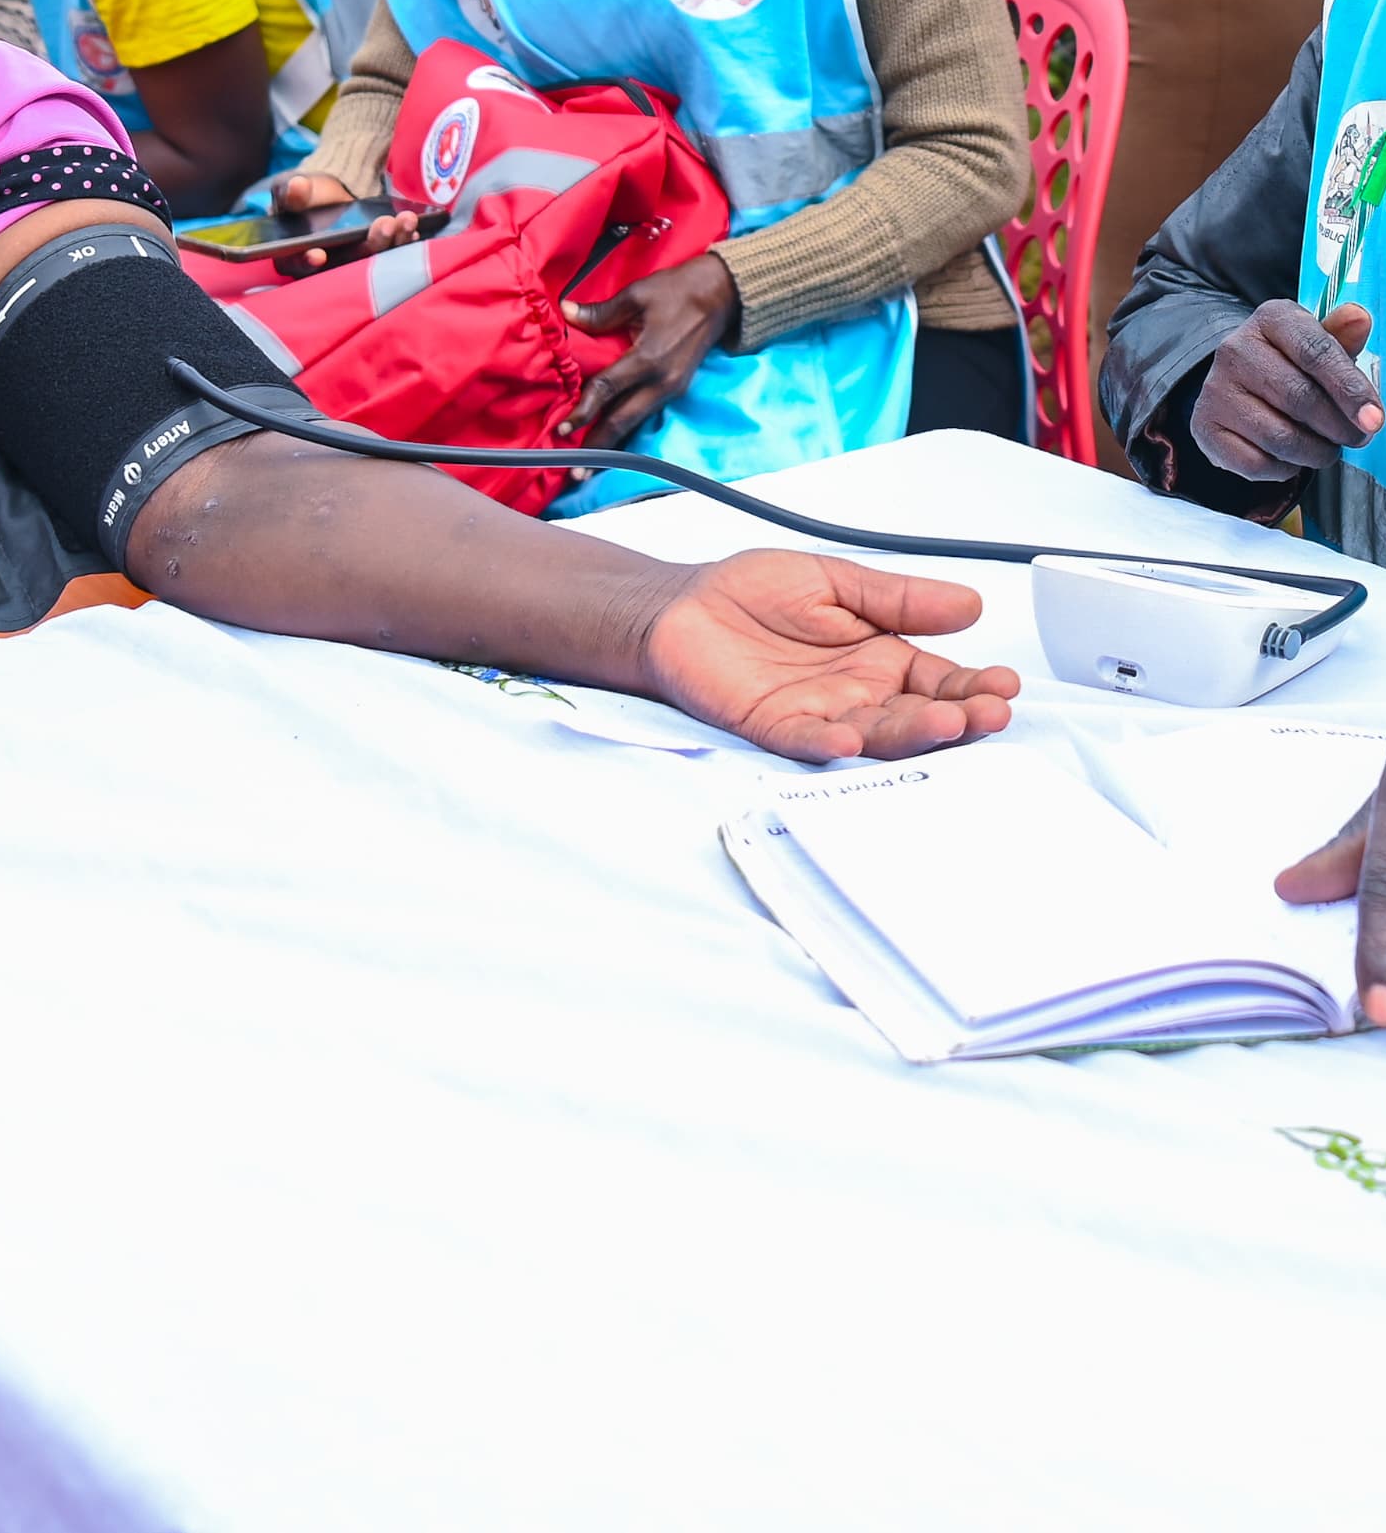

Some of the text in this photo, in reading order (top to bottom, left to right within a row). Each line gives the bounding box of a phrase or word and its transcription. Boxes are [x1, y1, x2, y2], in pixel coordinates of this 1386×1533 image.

[67, 245, 96, 262] OK
[103, 420, 191, 527] Artery Mark
[779, 779, 894, 801] Print Lion
